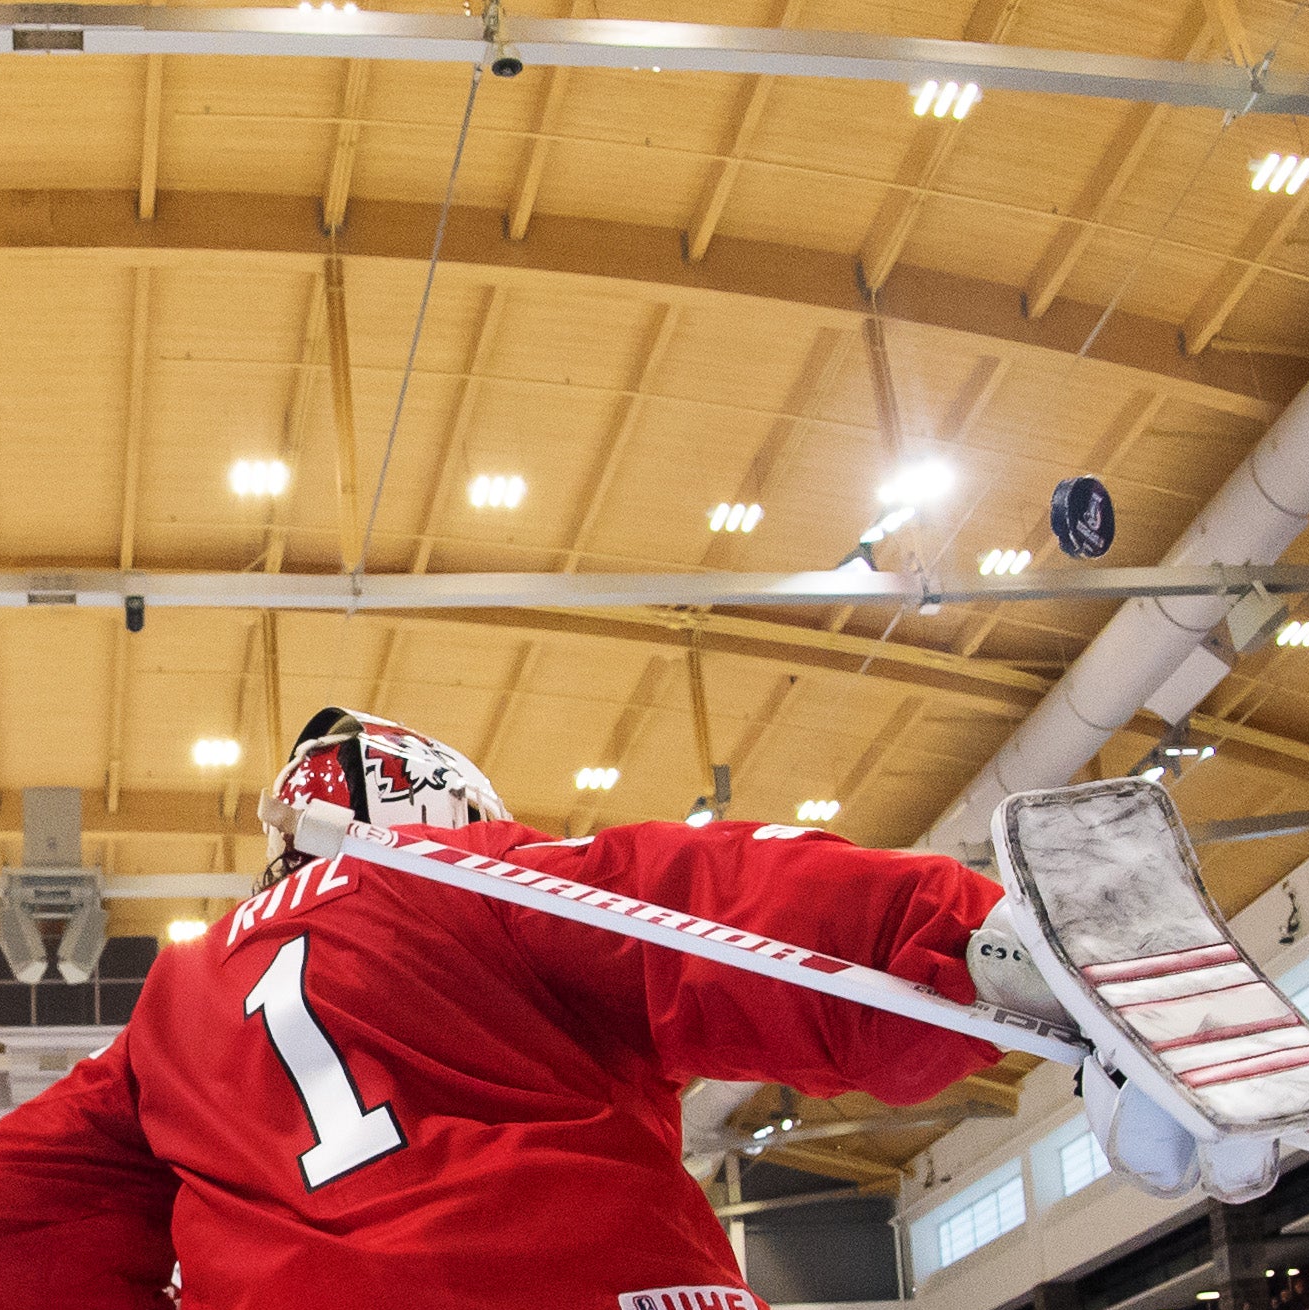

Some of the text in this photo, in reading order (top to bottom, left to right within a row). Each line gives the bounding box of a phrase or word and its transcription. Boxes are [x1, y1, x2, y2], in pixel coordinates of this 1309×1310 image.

[226, 853, 349, 947] RITZ
[452, 853, 814, 962] WARRIOR
[244, 930, 409, 1193] 1
